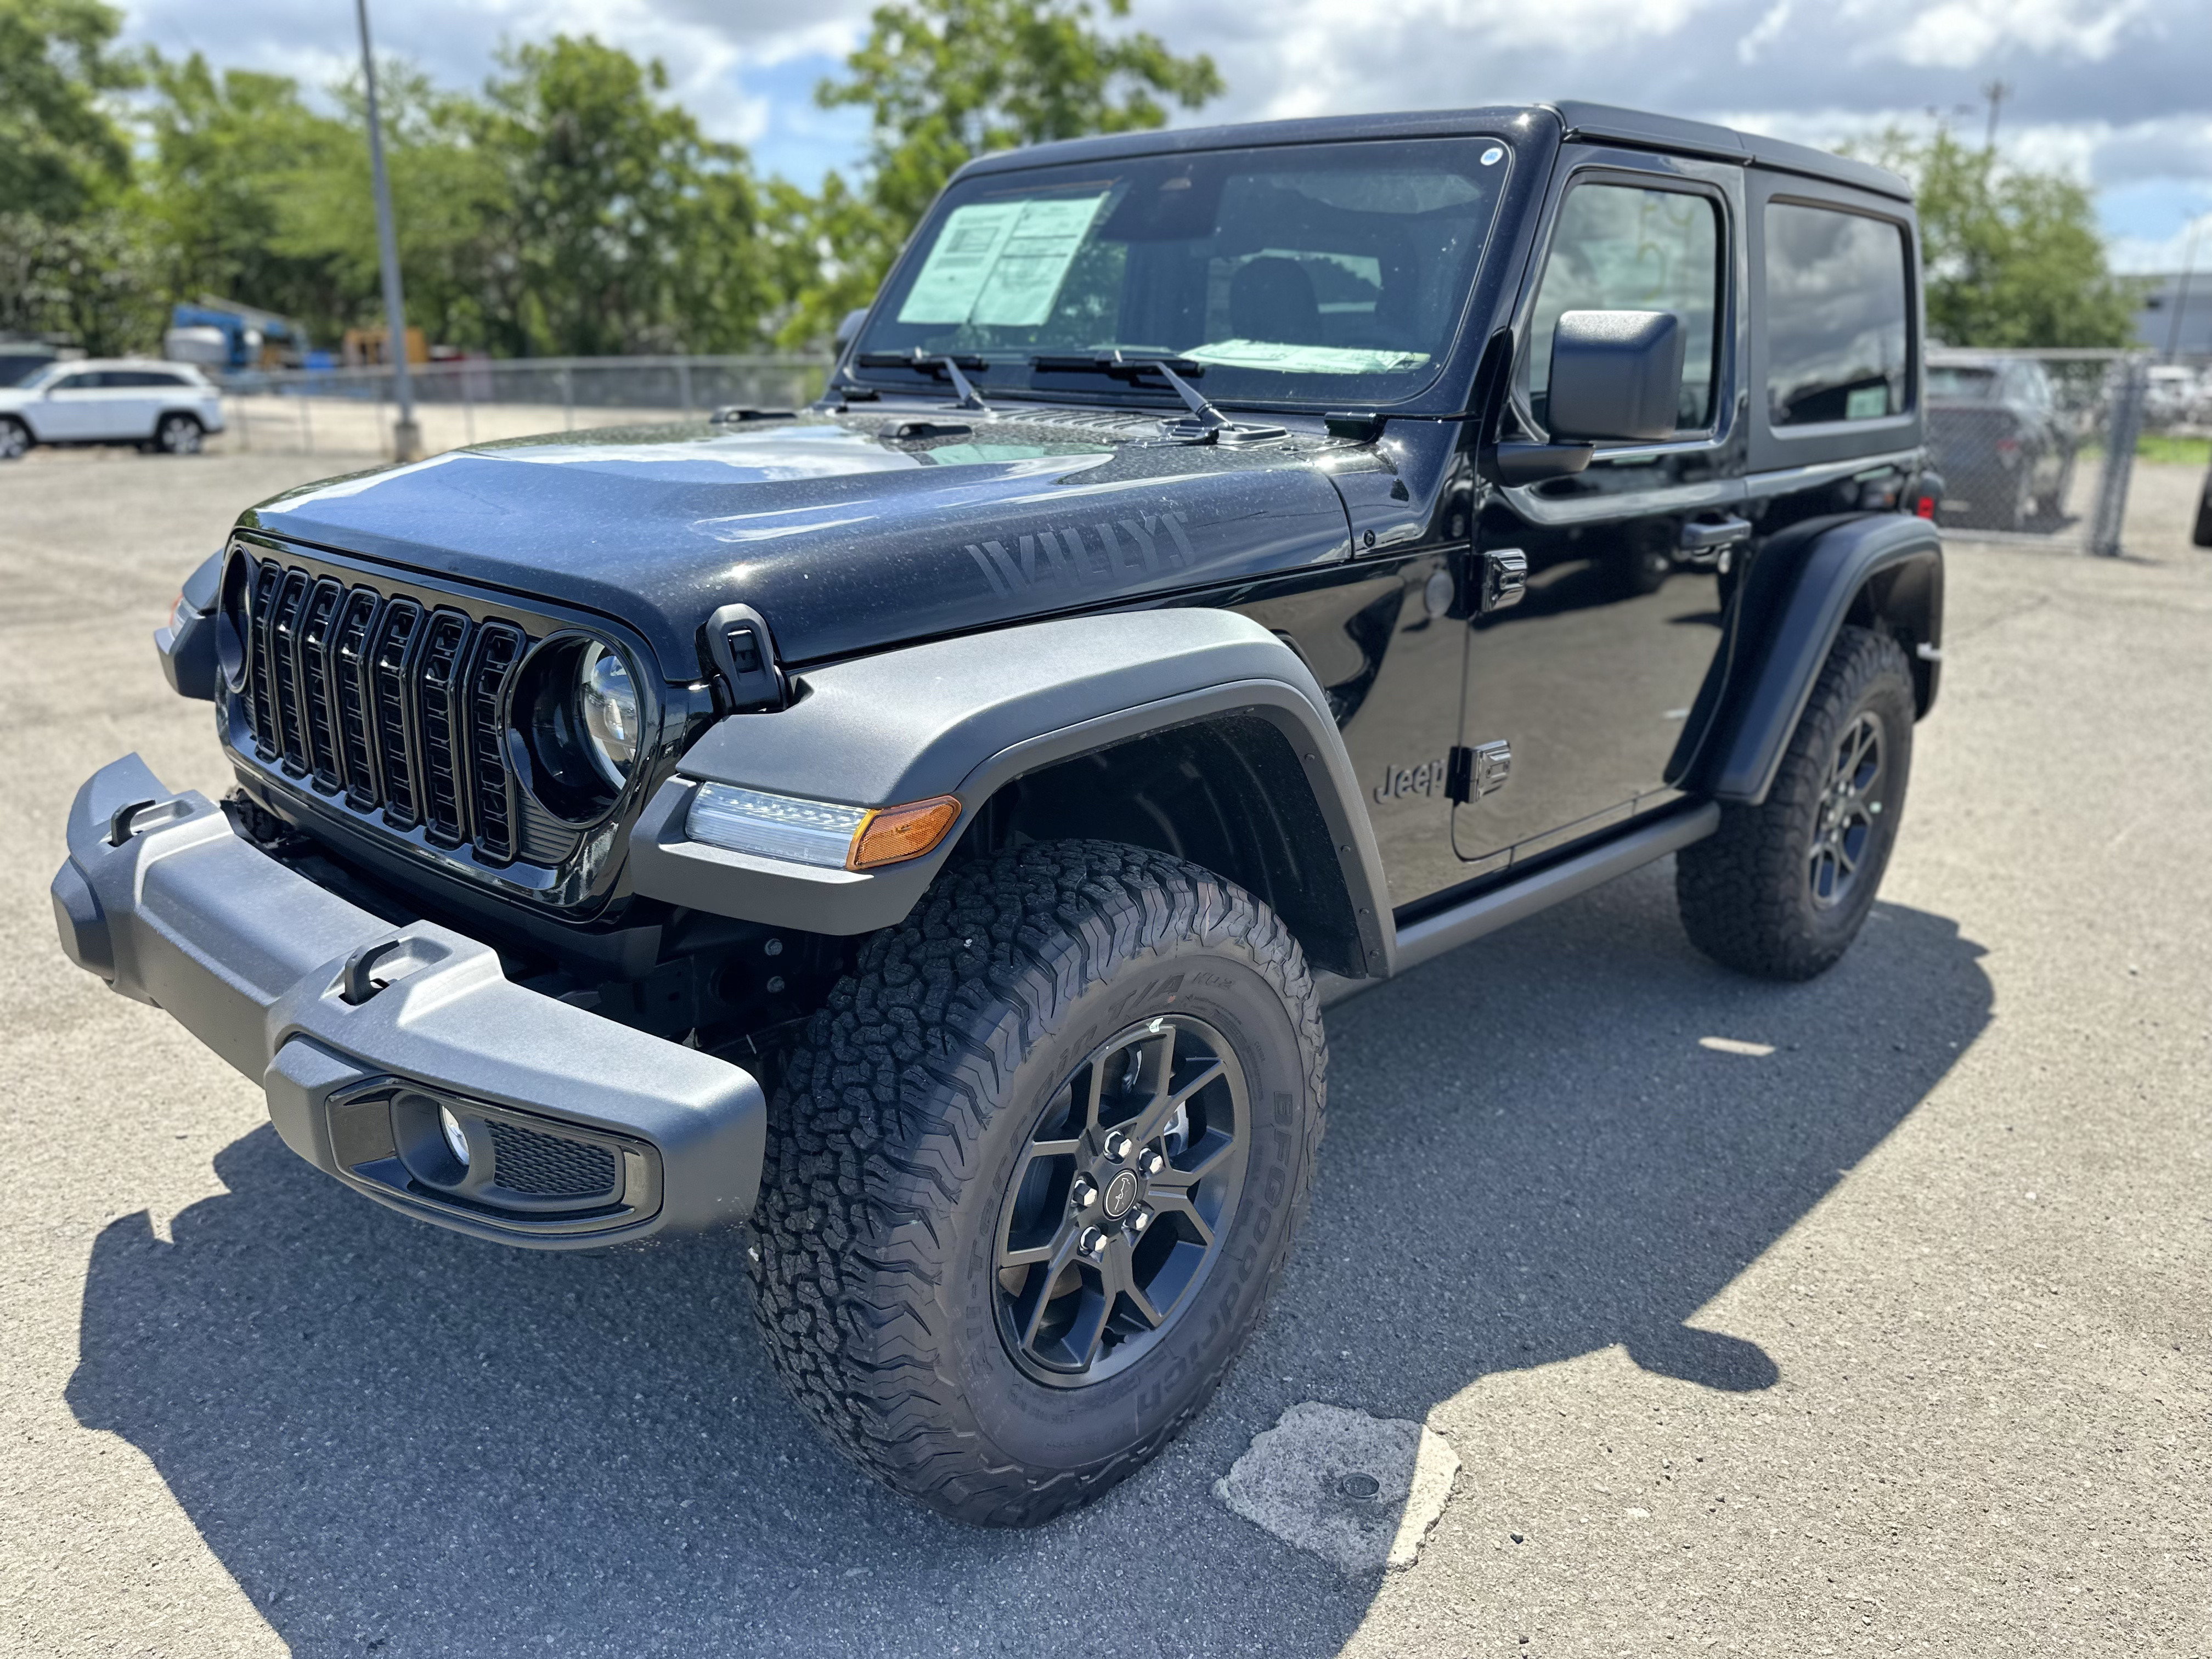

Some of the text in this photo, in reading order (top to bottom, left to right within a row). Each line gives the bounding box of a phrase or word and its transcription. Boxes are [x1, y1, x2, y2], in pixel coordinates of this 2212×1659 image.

[964, 511, 1195, 597] WILLYS
[1374, 759, 1447, 804] Jeep
[1108, 973, 1186, 1025] T/A
